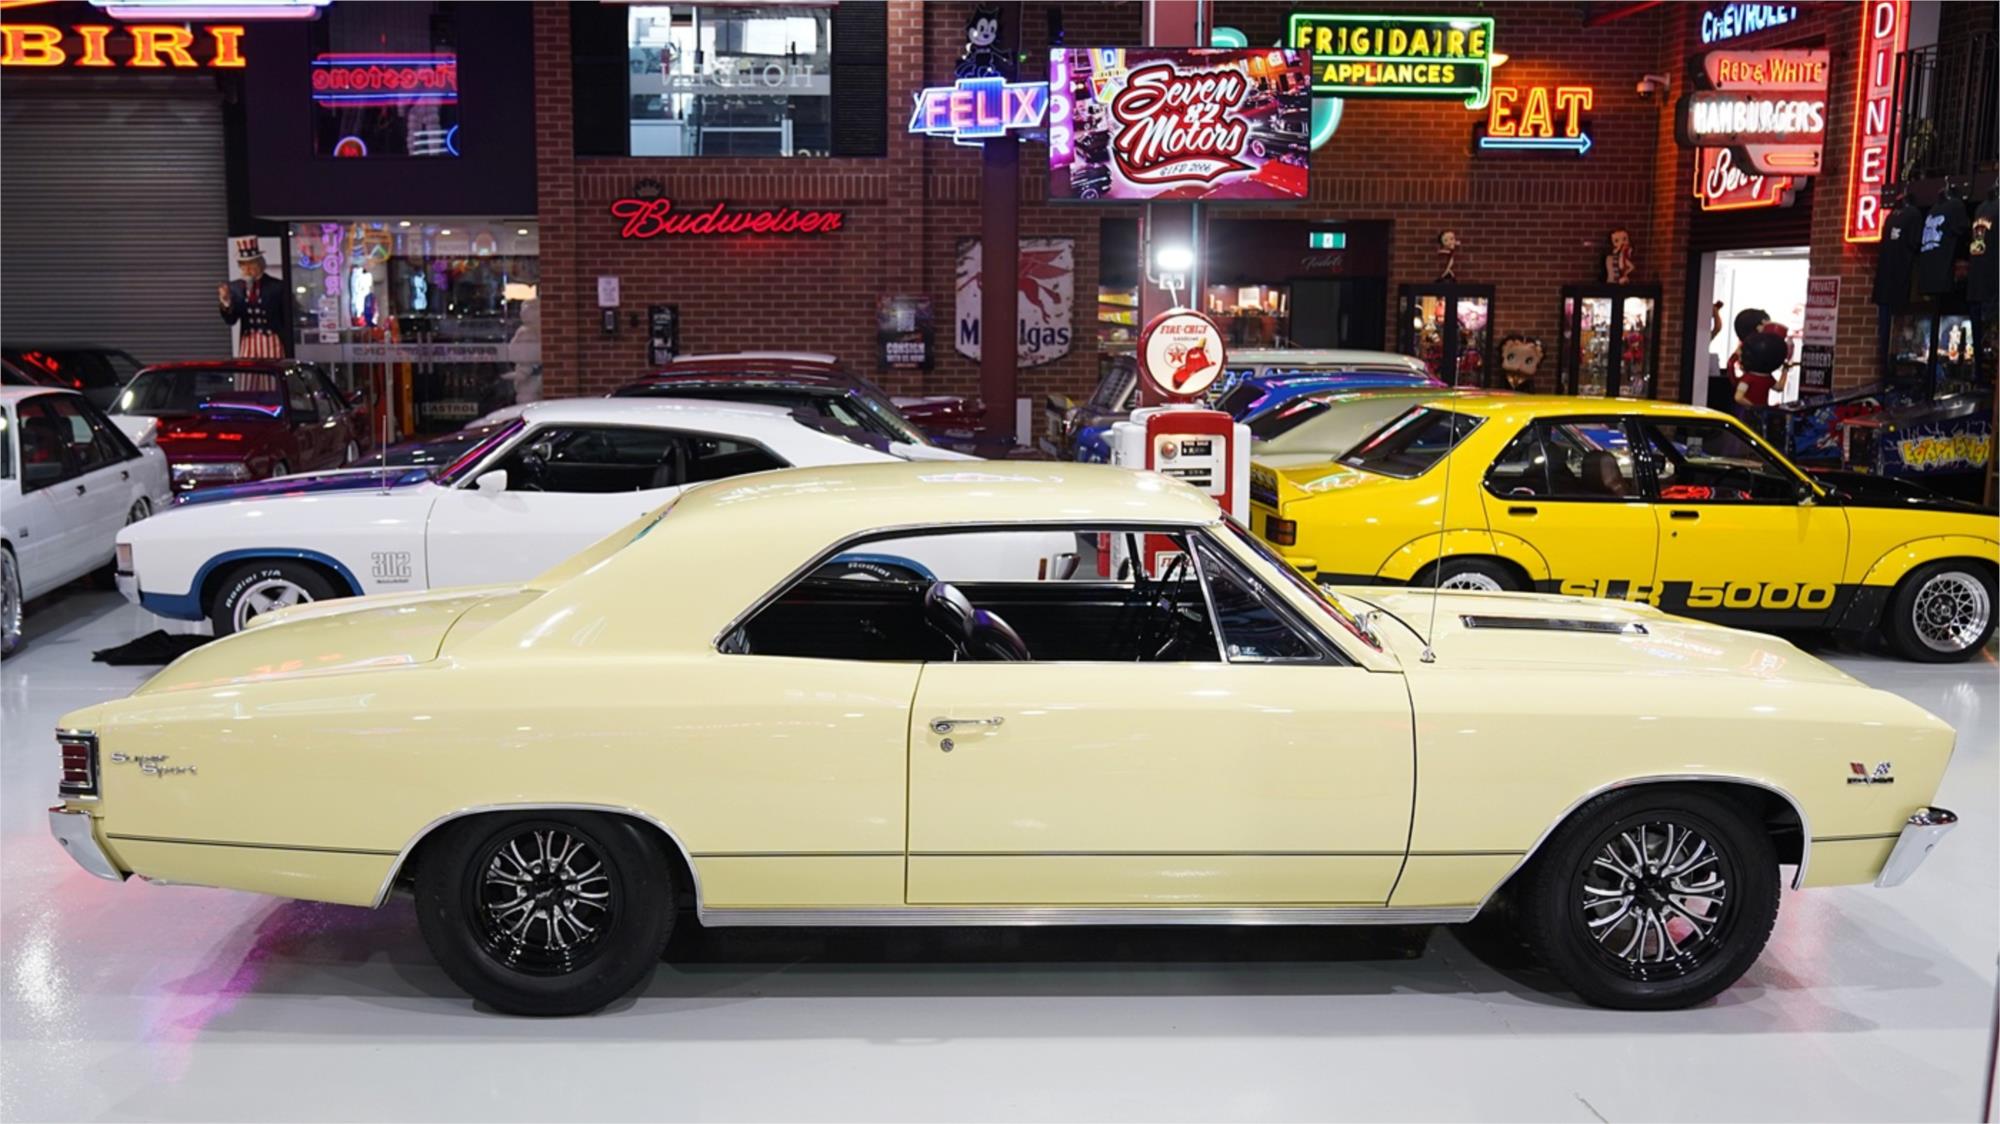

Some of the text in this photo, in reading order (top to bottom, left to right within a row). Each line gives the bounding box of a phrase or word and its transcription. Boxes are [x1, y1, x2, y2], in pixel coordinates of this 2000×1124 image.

[0, 24, 246, 67] BIRI
[1297, 26, 1486, 58] FRIGIDAIRE
[1323, 63, 1456, 83] APPLIANCES
[1720, 59, 1750, 81] RED
[1768, 59, 1823, 82] WHITE
[925, 89, 1040, 128] FELIX
[1118, 70, 1240, 121] Seven
[1488, 87, 1593, 137] EAT
[1183, 103, 1219, 124] 82
[1693, 100, 1824, 134] HAMBURGERS
[1856, 2, 1894, 230] DINER
[1120, 116, 1242, 165] Motors
[611, 198, 843, 239] Budweiser
[960, 318, 1069, 353] Mlgas
[371, 551, 412, 578] 302
[848, 561, 891, 578] Radial
[225, 569, 281, 608] Radial T/A
[1687, 581, 1836, 610] 5000
[111, 752, 170, 767] Super
[142, 762, 198, 778] Sport
